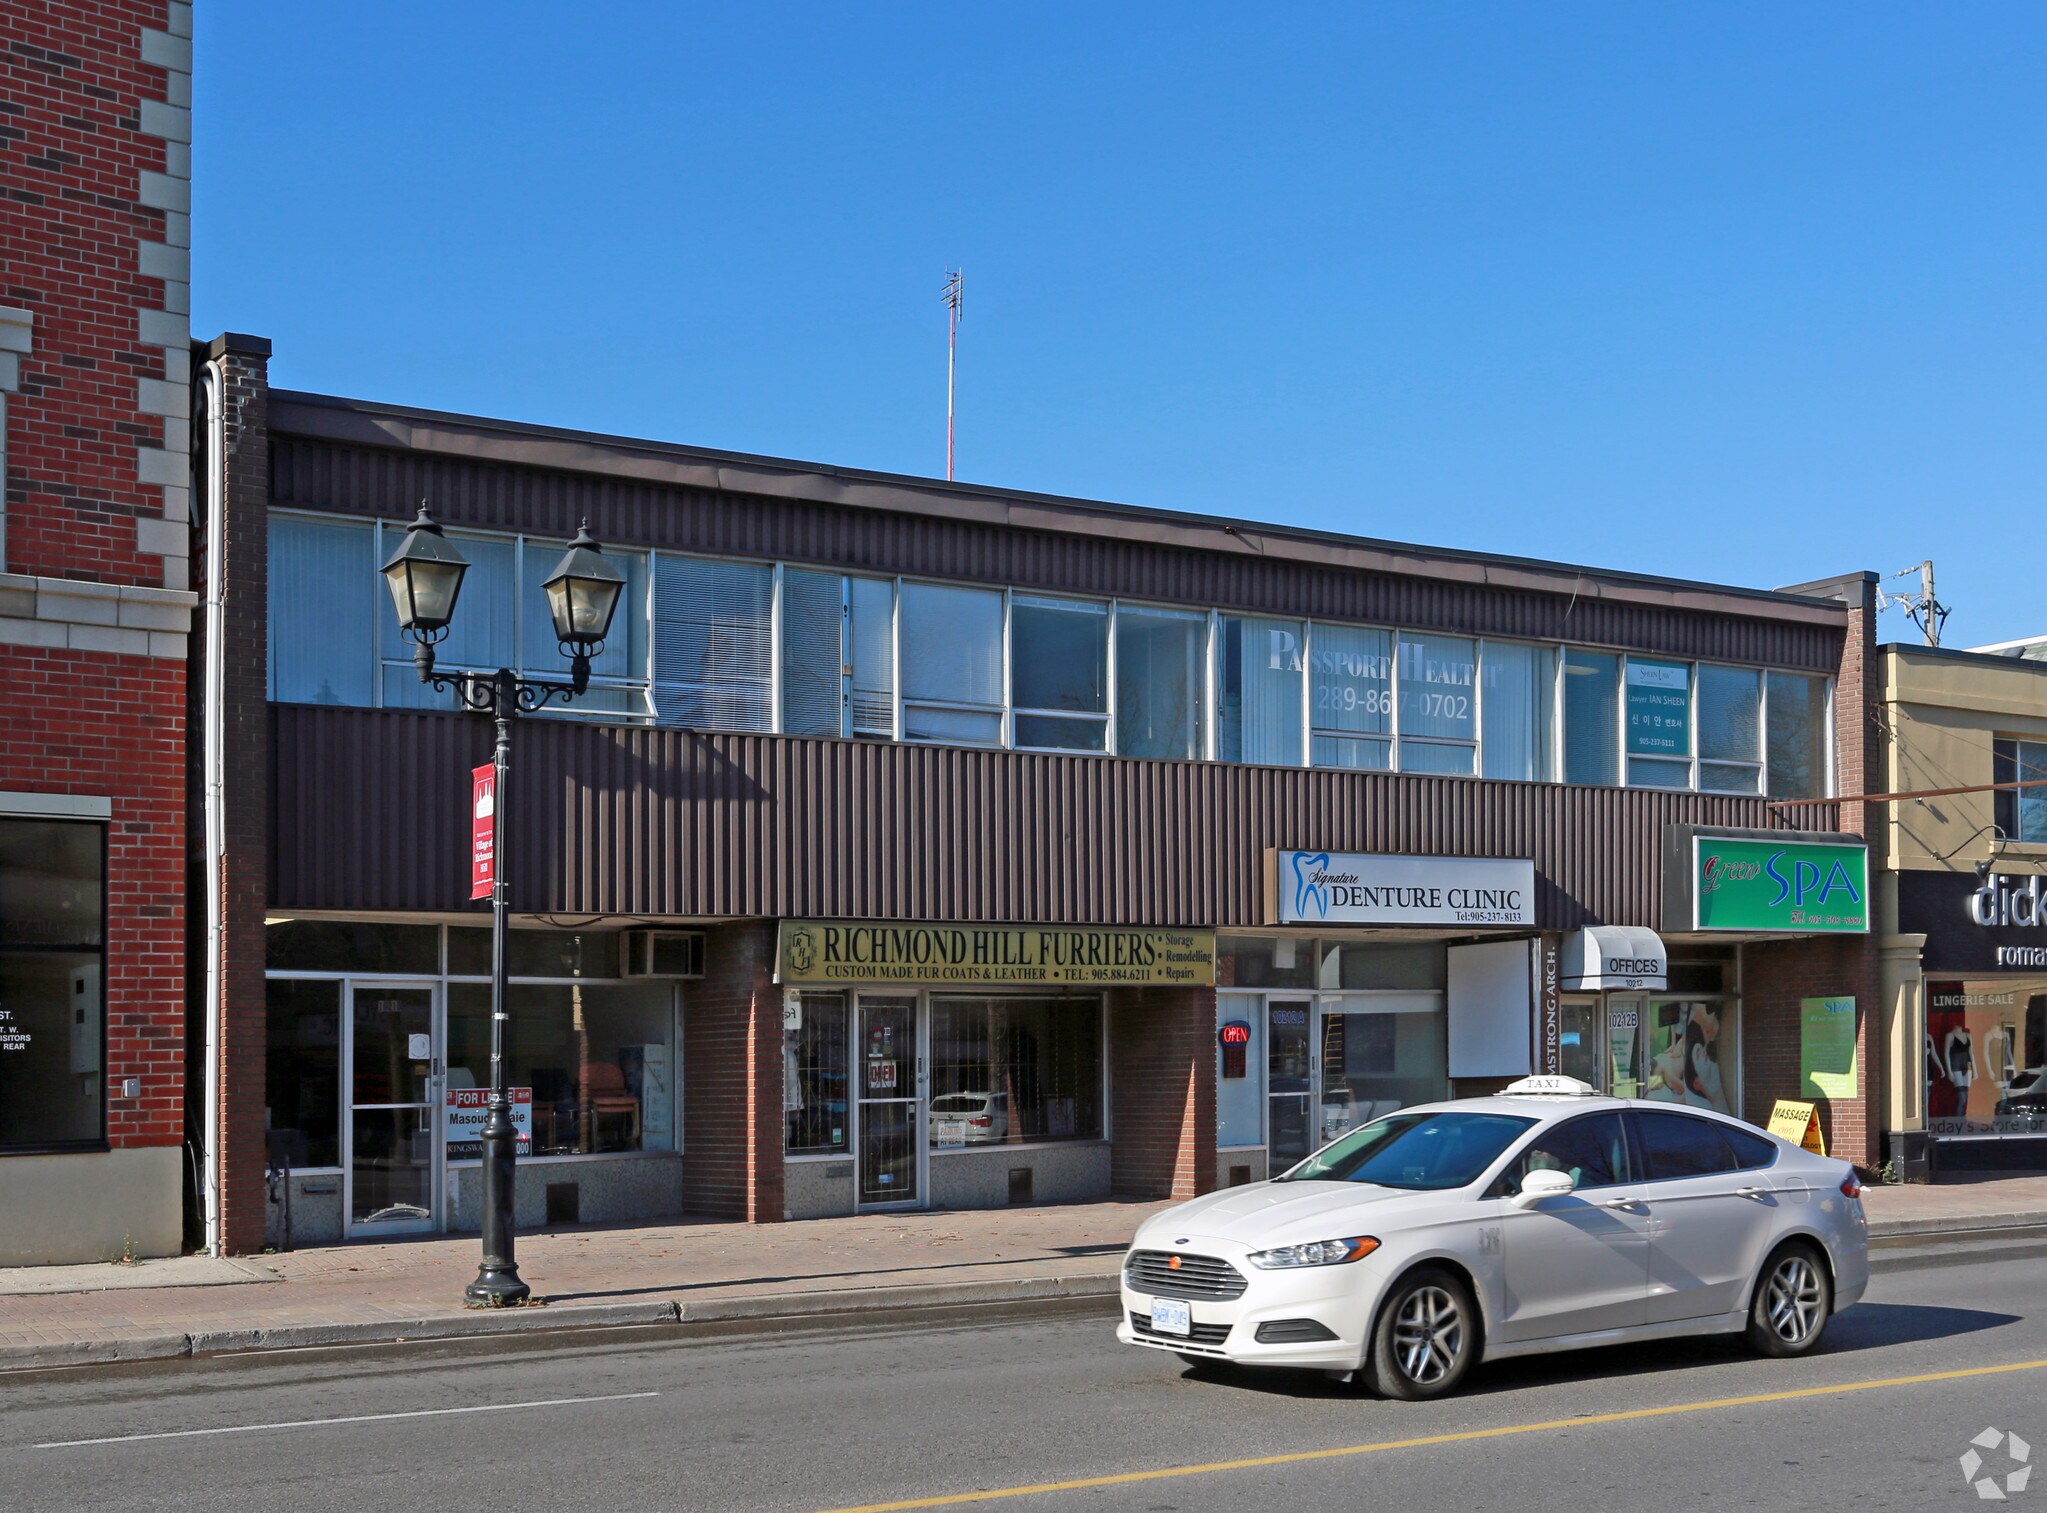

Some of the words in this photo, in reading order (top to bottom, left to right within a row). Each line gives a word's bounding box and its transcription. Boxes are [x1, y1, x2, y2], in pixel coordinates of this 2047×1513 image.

[1640, 667, 1657, 679] SHEEN
[1628, 694, 1647, 703] Lawyer
[1649, 694, 1661, 704] IAN
[1663, 695, 1685, 706] SHEEN
[1308, 868, 1359, 889] Signature
[1765, 850, 1860, 907] SPA
[1331, 885, 1442, 909] DENTURE
[1447, 888, 1521, 910] CLINIC
[823, 927, 967, 965] RICHMOND
[971, 930, 1033, 966] HILL
[1038, 931, 1155, 967] FURRIERS
[1165, 933, 1194, 947] Storage
[1166, 949, 1212, 965] Remodelling
[1998, 946, 2047, 966] roma
[825, 965, 876, 978] CUSTOM
[879, 966, 914, 979] MADE
[916, 966, 940, 979] FUR
[942, 966, 980, 979] COATS
[982, 968, 991, 979] &
[995, 967, 1047, 980] LEATHER
[1063, 968, 1089, 981] TEL:
[1091, 969, 1150, 981] 905.884.6211
[1546, 946, 1556, 993] ARCH.
[1609, 958, 1659, 973] OFFICES
[1166, 966, 1195, 982] Repairs
[1625, 979, 1644, 988] 10212
[1824, 1000, 1854, 1014] SPA
[1933, 994, 1985, 1006] LINGERIE
[1987, 993, 2014, 1005] SALE
[1223, 1026, 1248, 1043] OPEN
[870, 1065, 895, 1083] OPEN
[1527, 1079, 1560, 1088] TAXI
[457, 1092, 479, 1104] FOR
[1773, 1107, 1810, 1122] MASSAGE
[447, 1143, 483, 1153] KINGSWA
